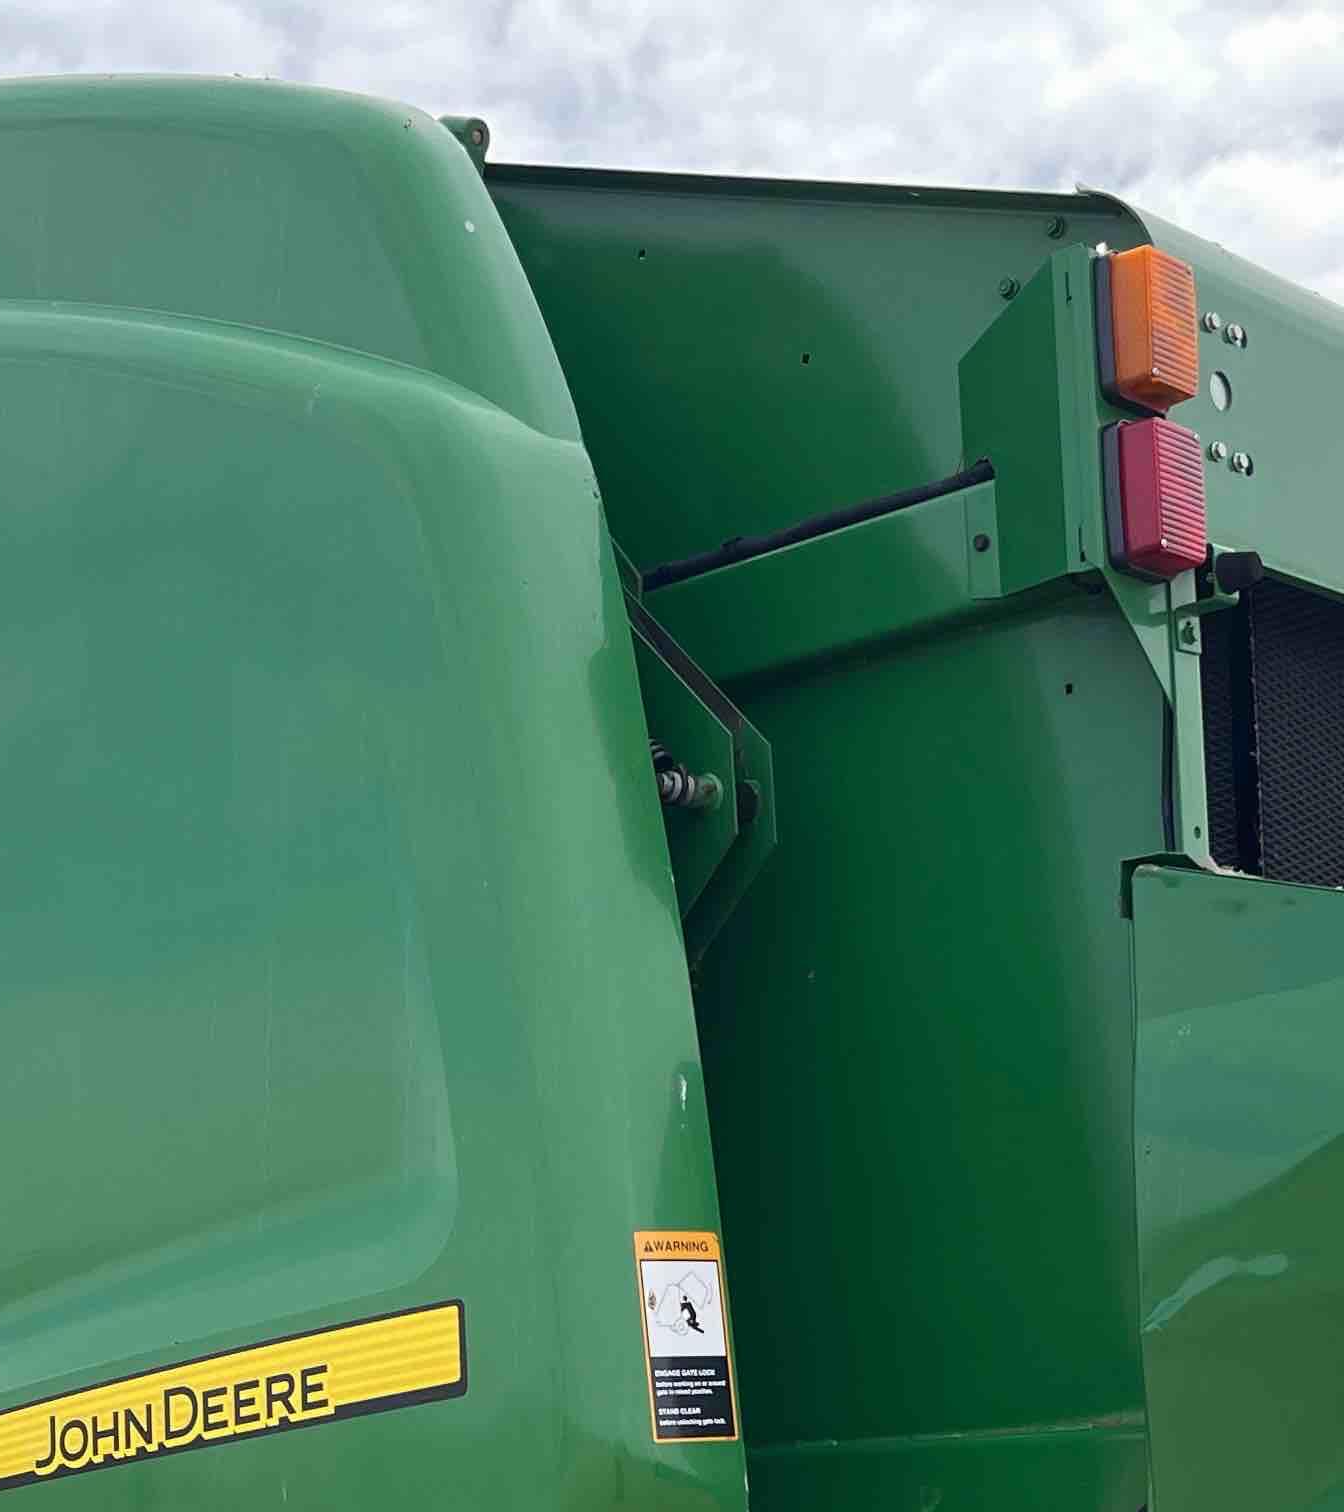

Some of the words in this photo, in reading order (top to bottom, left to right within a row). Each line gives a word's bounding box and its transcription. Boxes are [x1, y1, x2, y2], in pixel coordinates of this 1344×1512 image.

[653, 1240, 709, 1252] WARNING
[35, 1401, 153, 1470] JOHN
[163, 1364, 329, 1441] DEERE
